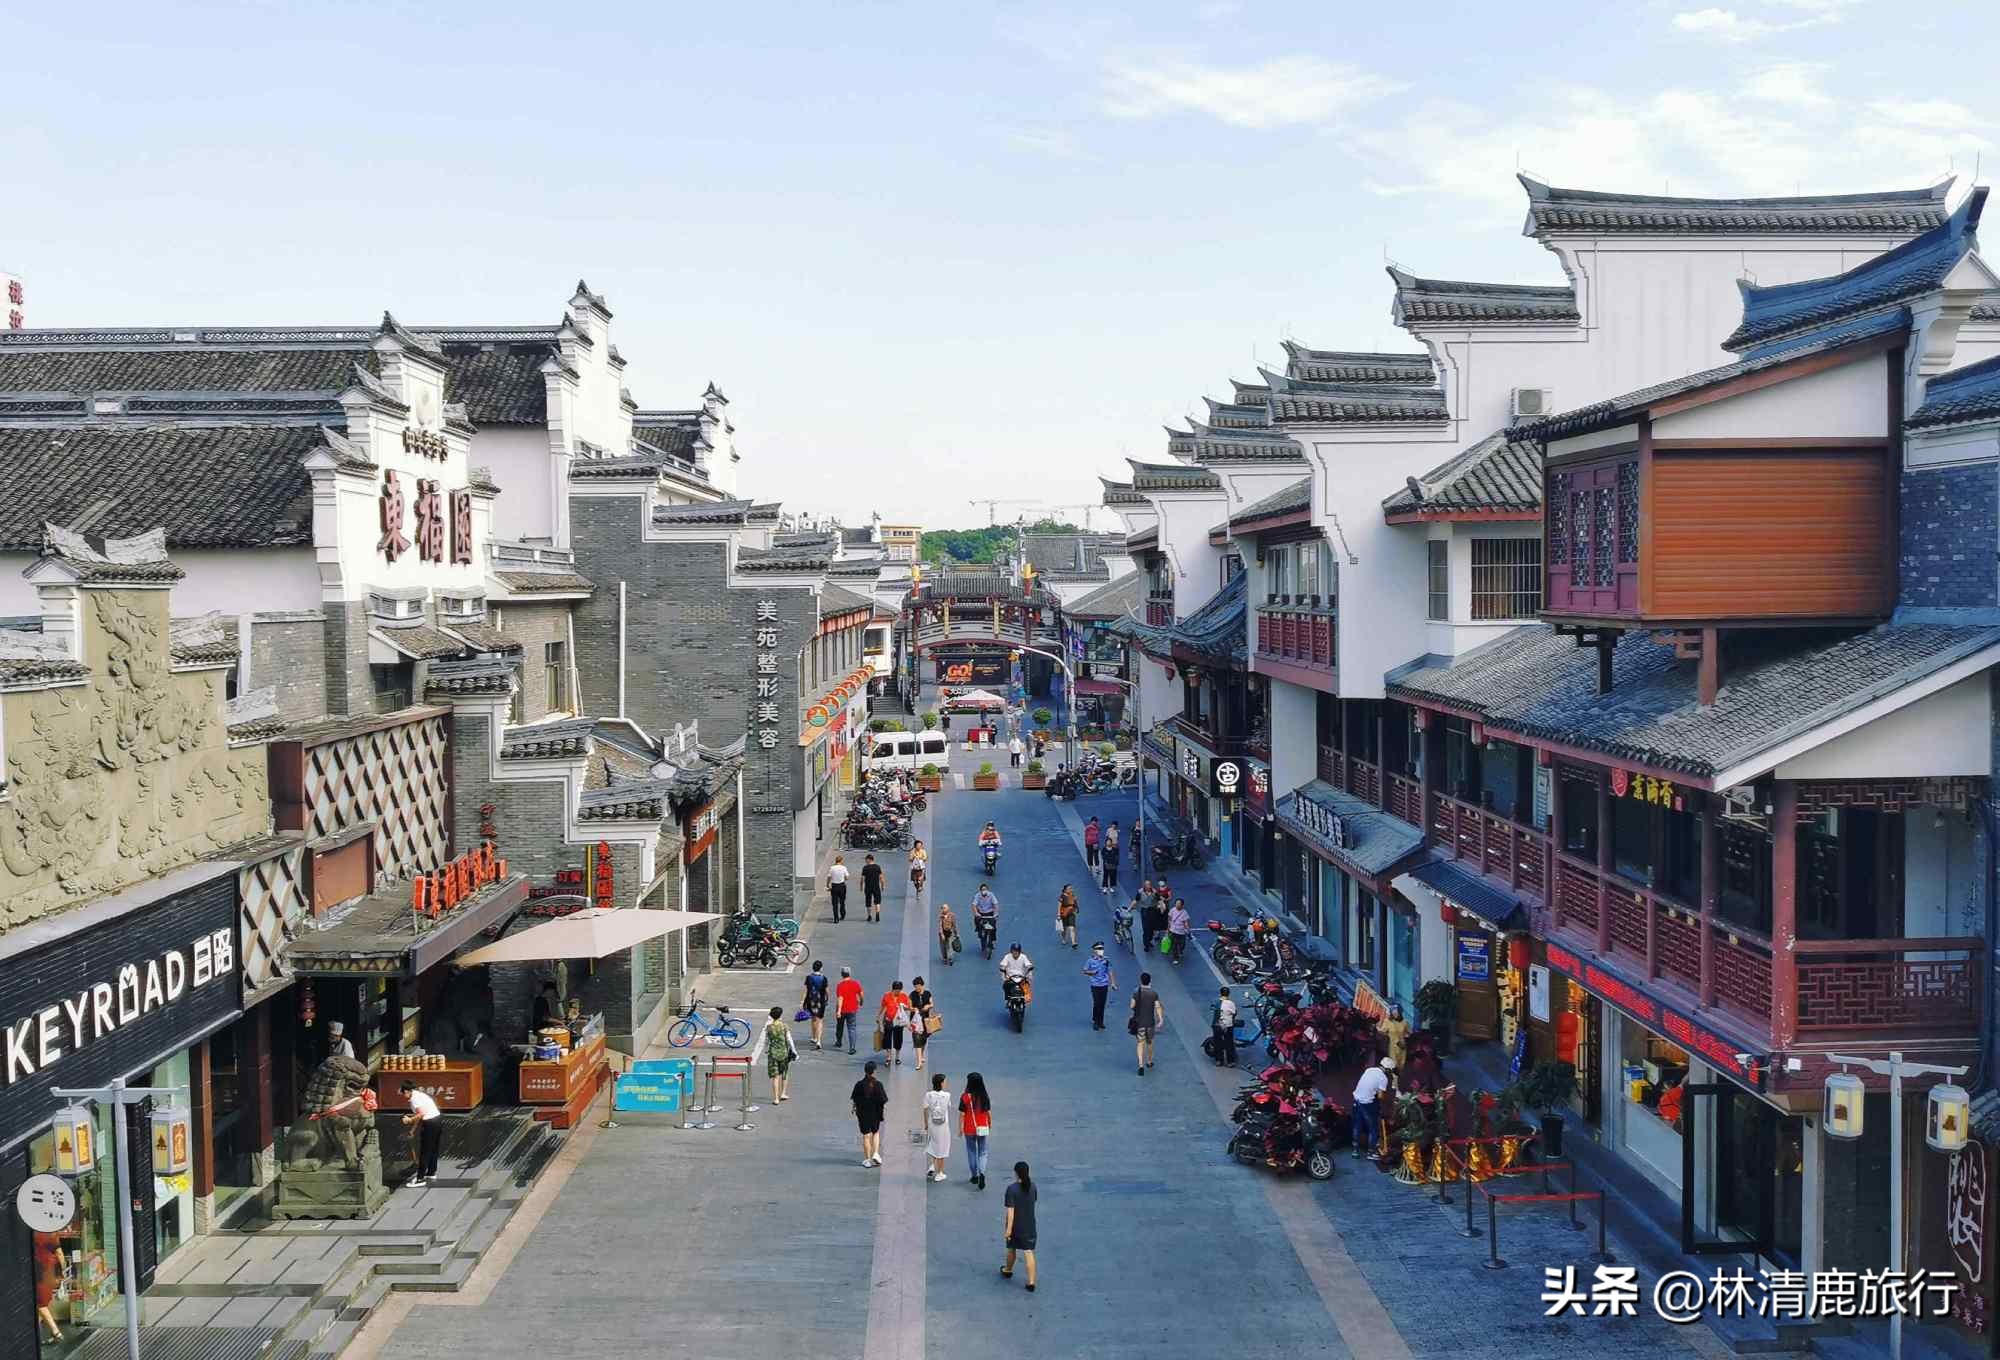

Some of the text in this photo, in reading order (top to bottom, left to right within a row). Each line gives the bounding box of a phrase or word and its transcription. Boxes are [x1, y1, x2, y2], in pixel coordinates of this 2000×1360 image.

[756, 599, 780, 749] 美苑整形美容
[6, 950, 185, 1084] KEYROAD
